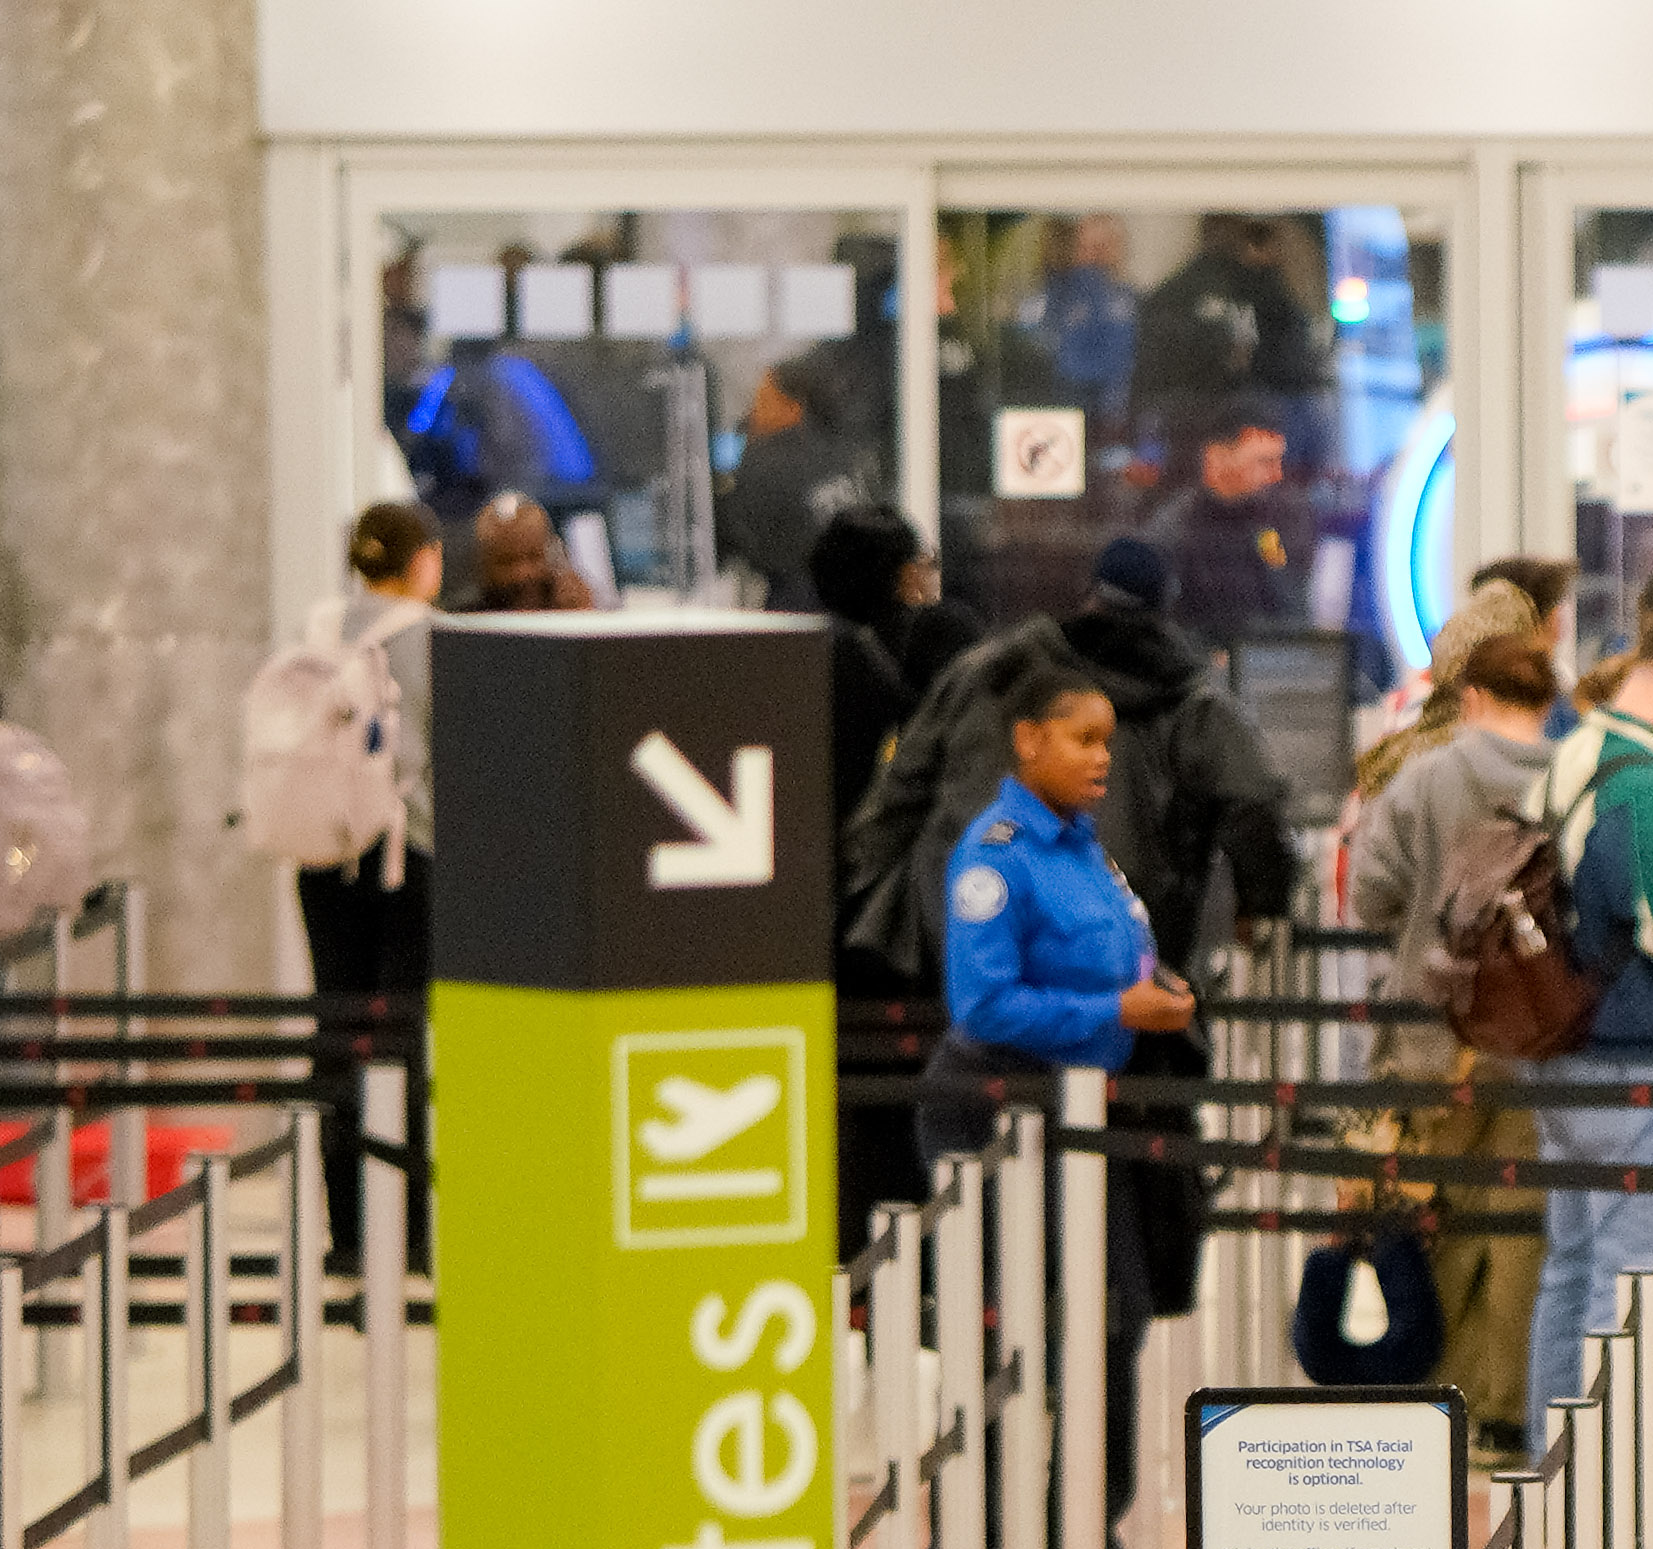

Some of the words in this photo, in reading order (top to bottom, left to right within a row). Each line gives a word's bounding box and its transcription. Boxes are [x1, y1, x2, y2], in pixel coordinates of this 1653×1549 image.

[1238, 1440, 1326, 1455] Participation
[1330, 1440, 1343, 1452] in
[1346, 1440, 1373, 1453] TSA
[1376, 1439, 1413, 1453] facial
[1246, 1457, 1324, 1471] recognition
[1327, 1457, 1405, 1471] technology
[1288, 1473, 1299, 1485] is
[1302, 1473, 1363, 1487] optional.
[1235, 1503, 1266, 1516] Your
[1271, 1502, 1311, 1516] photo
[1315, 1503, 1326, 1515] is
[1329, 1502, 1380, 1515] deleted
[1384, 1501, 1417, 1515] after
[1261, 1518, 1315, 1533] identity
[1319, 1519, 1330, 1531] is
[1334, 1518, 1391, 1532] verified.
